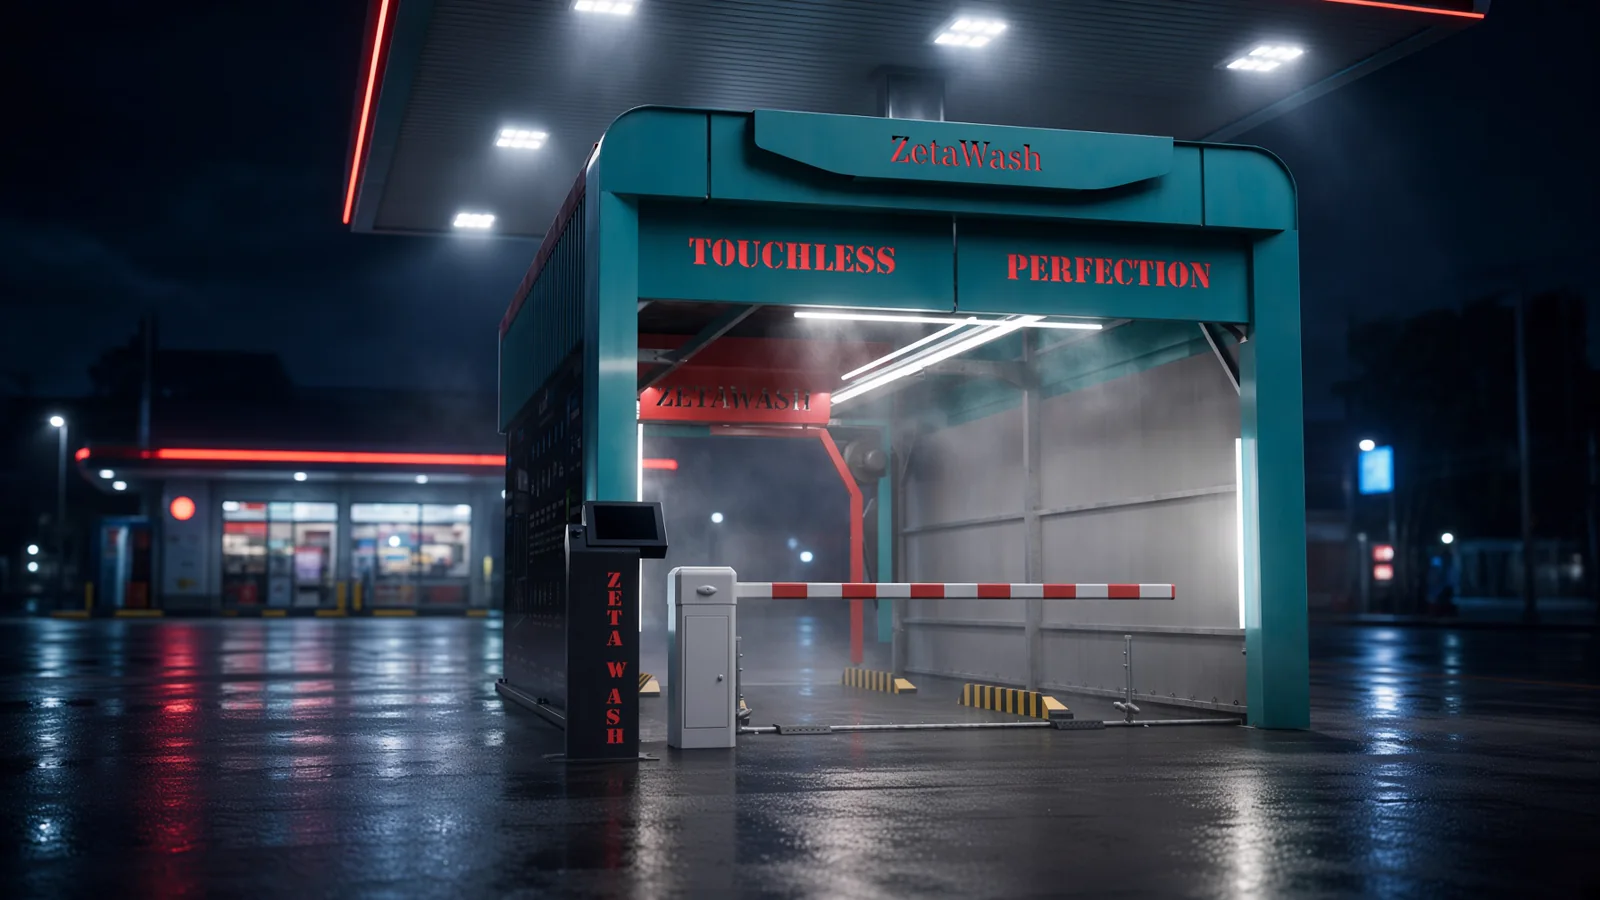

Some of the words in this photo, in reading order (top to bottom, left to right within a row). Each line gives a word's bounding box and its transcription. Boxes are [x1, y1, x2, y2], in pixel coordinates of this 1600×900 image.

[891, 135, 1042, 171] ZetaWash
[688, 237, 896, 275] TOUCHLESS
[1007, 253, 1211, 288] PERFECTION
[656, 386, 811, 411] ZETAWASH
[606, 571, 623, 646] ZETA
[606, 661, 627, 744] WASH
